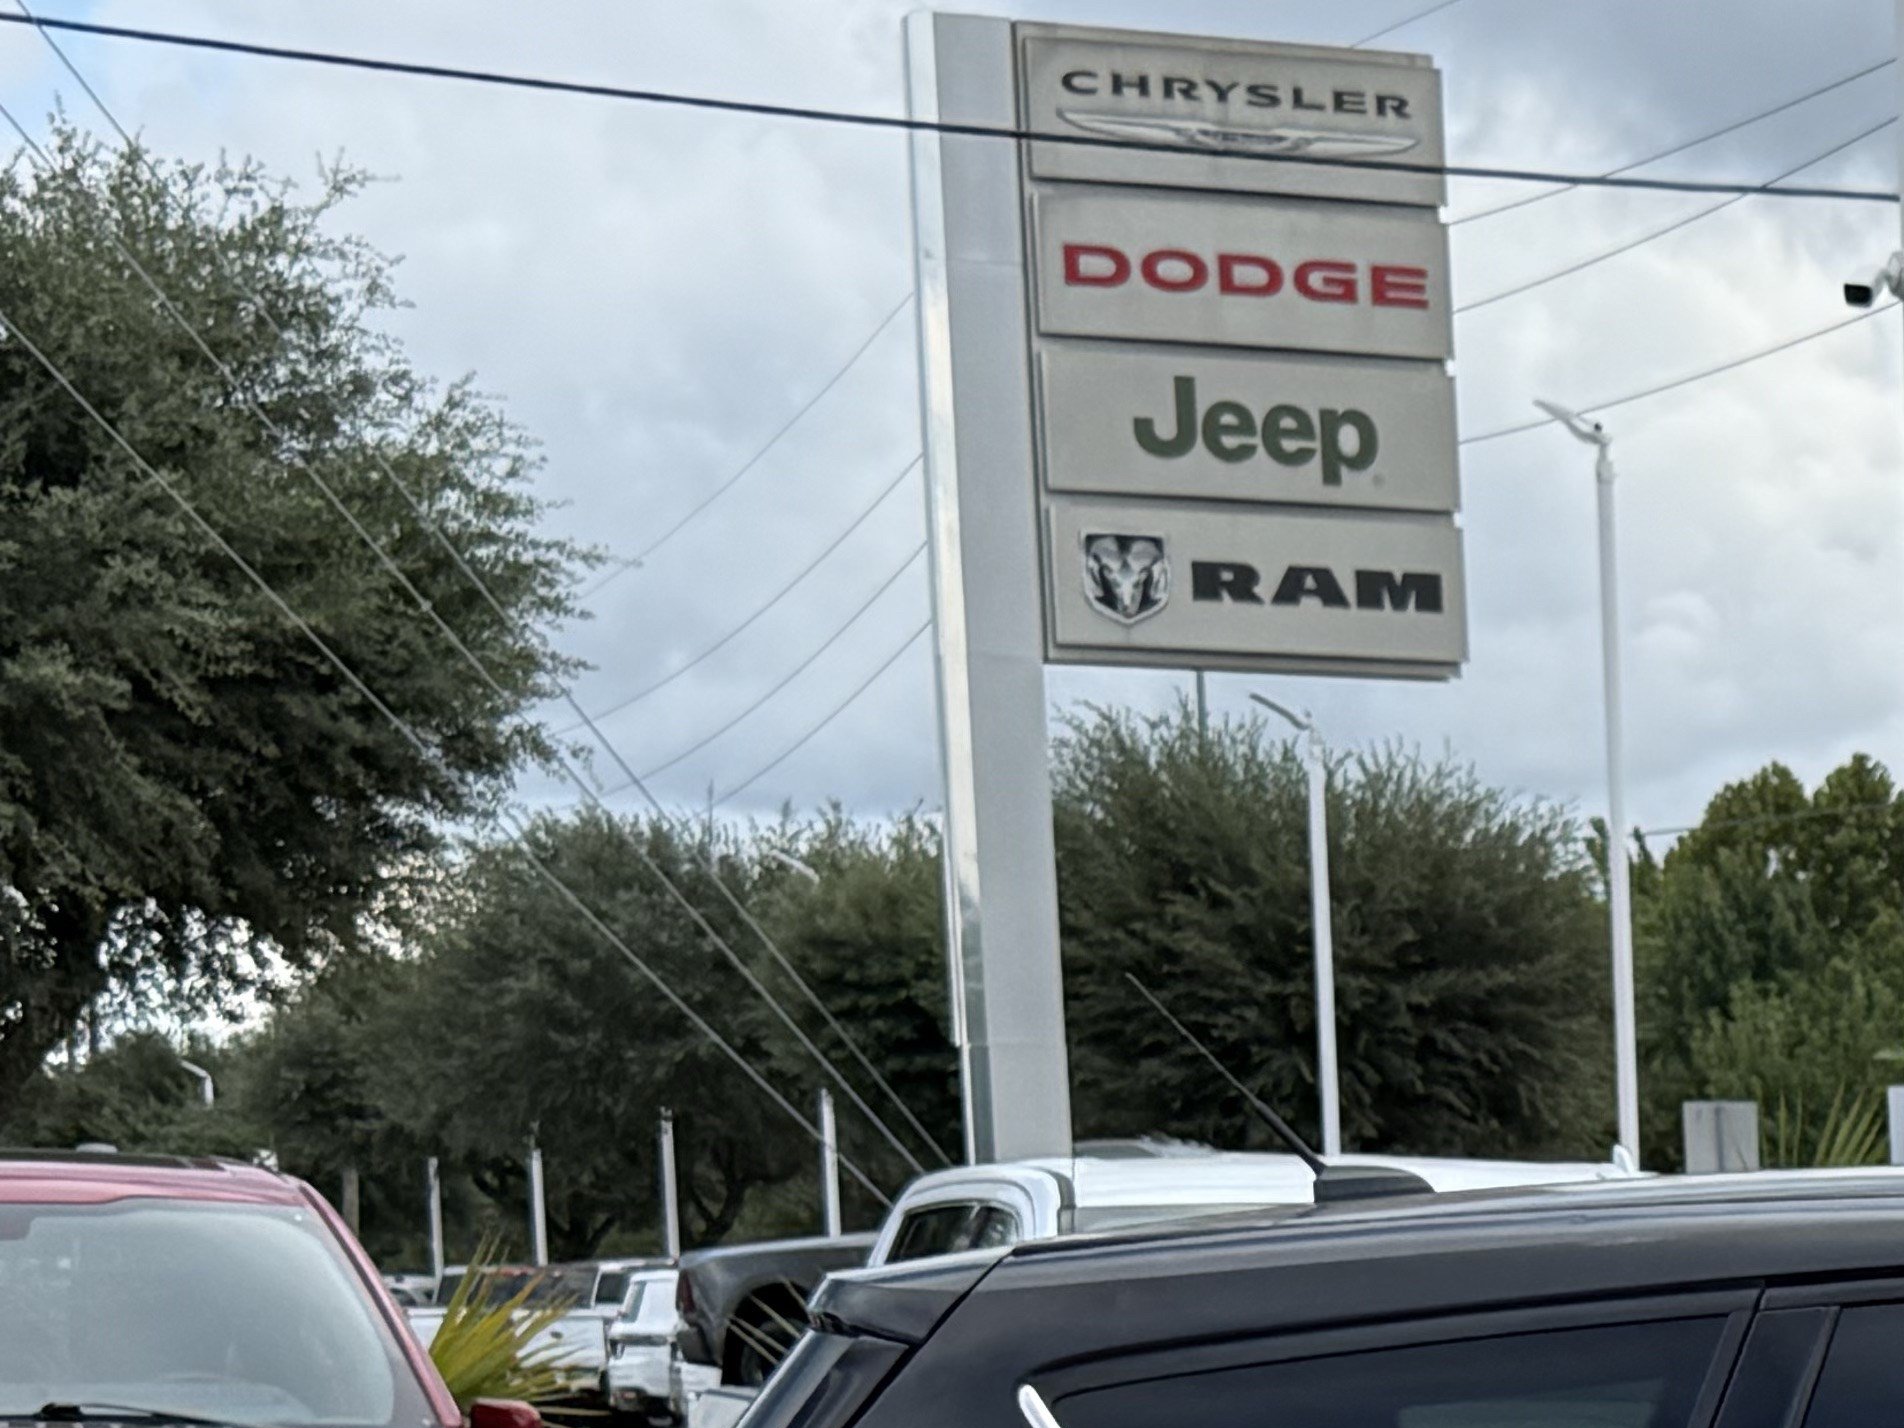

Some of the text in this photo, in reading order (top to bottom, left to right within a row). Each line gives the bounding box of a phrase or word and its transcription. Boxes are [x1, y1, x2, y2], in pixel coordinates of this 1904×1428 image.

[1061, 70, 1411, 119] CHRYSLER
[1063, 243, 1430, 309] DODGE
[1133, 375, 1379, 486] Jeep
[1191, 560, 1444, 613] RAM
